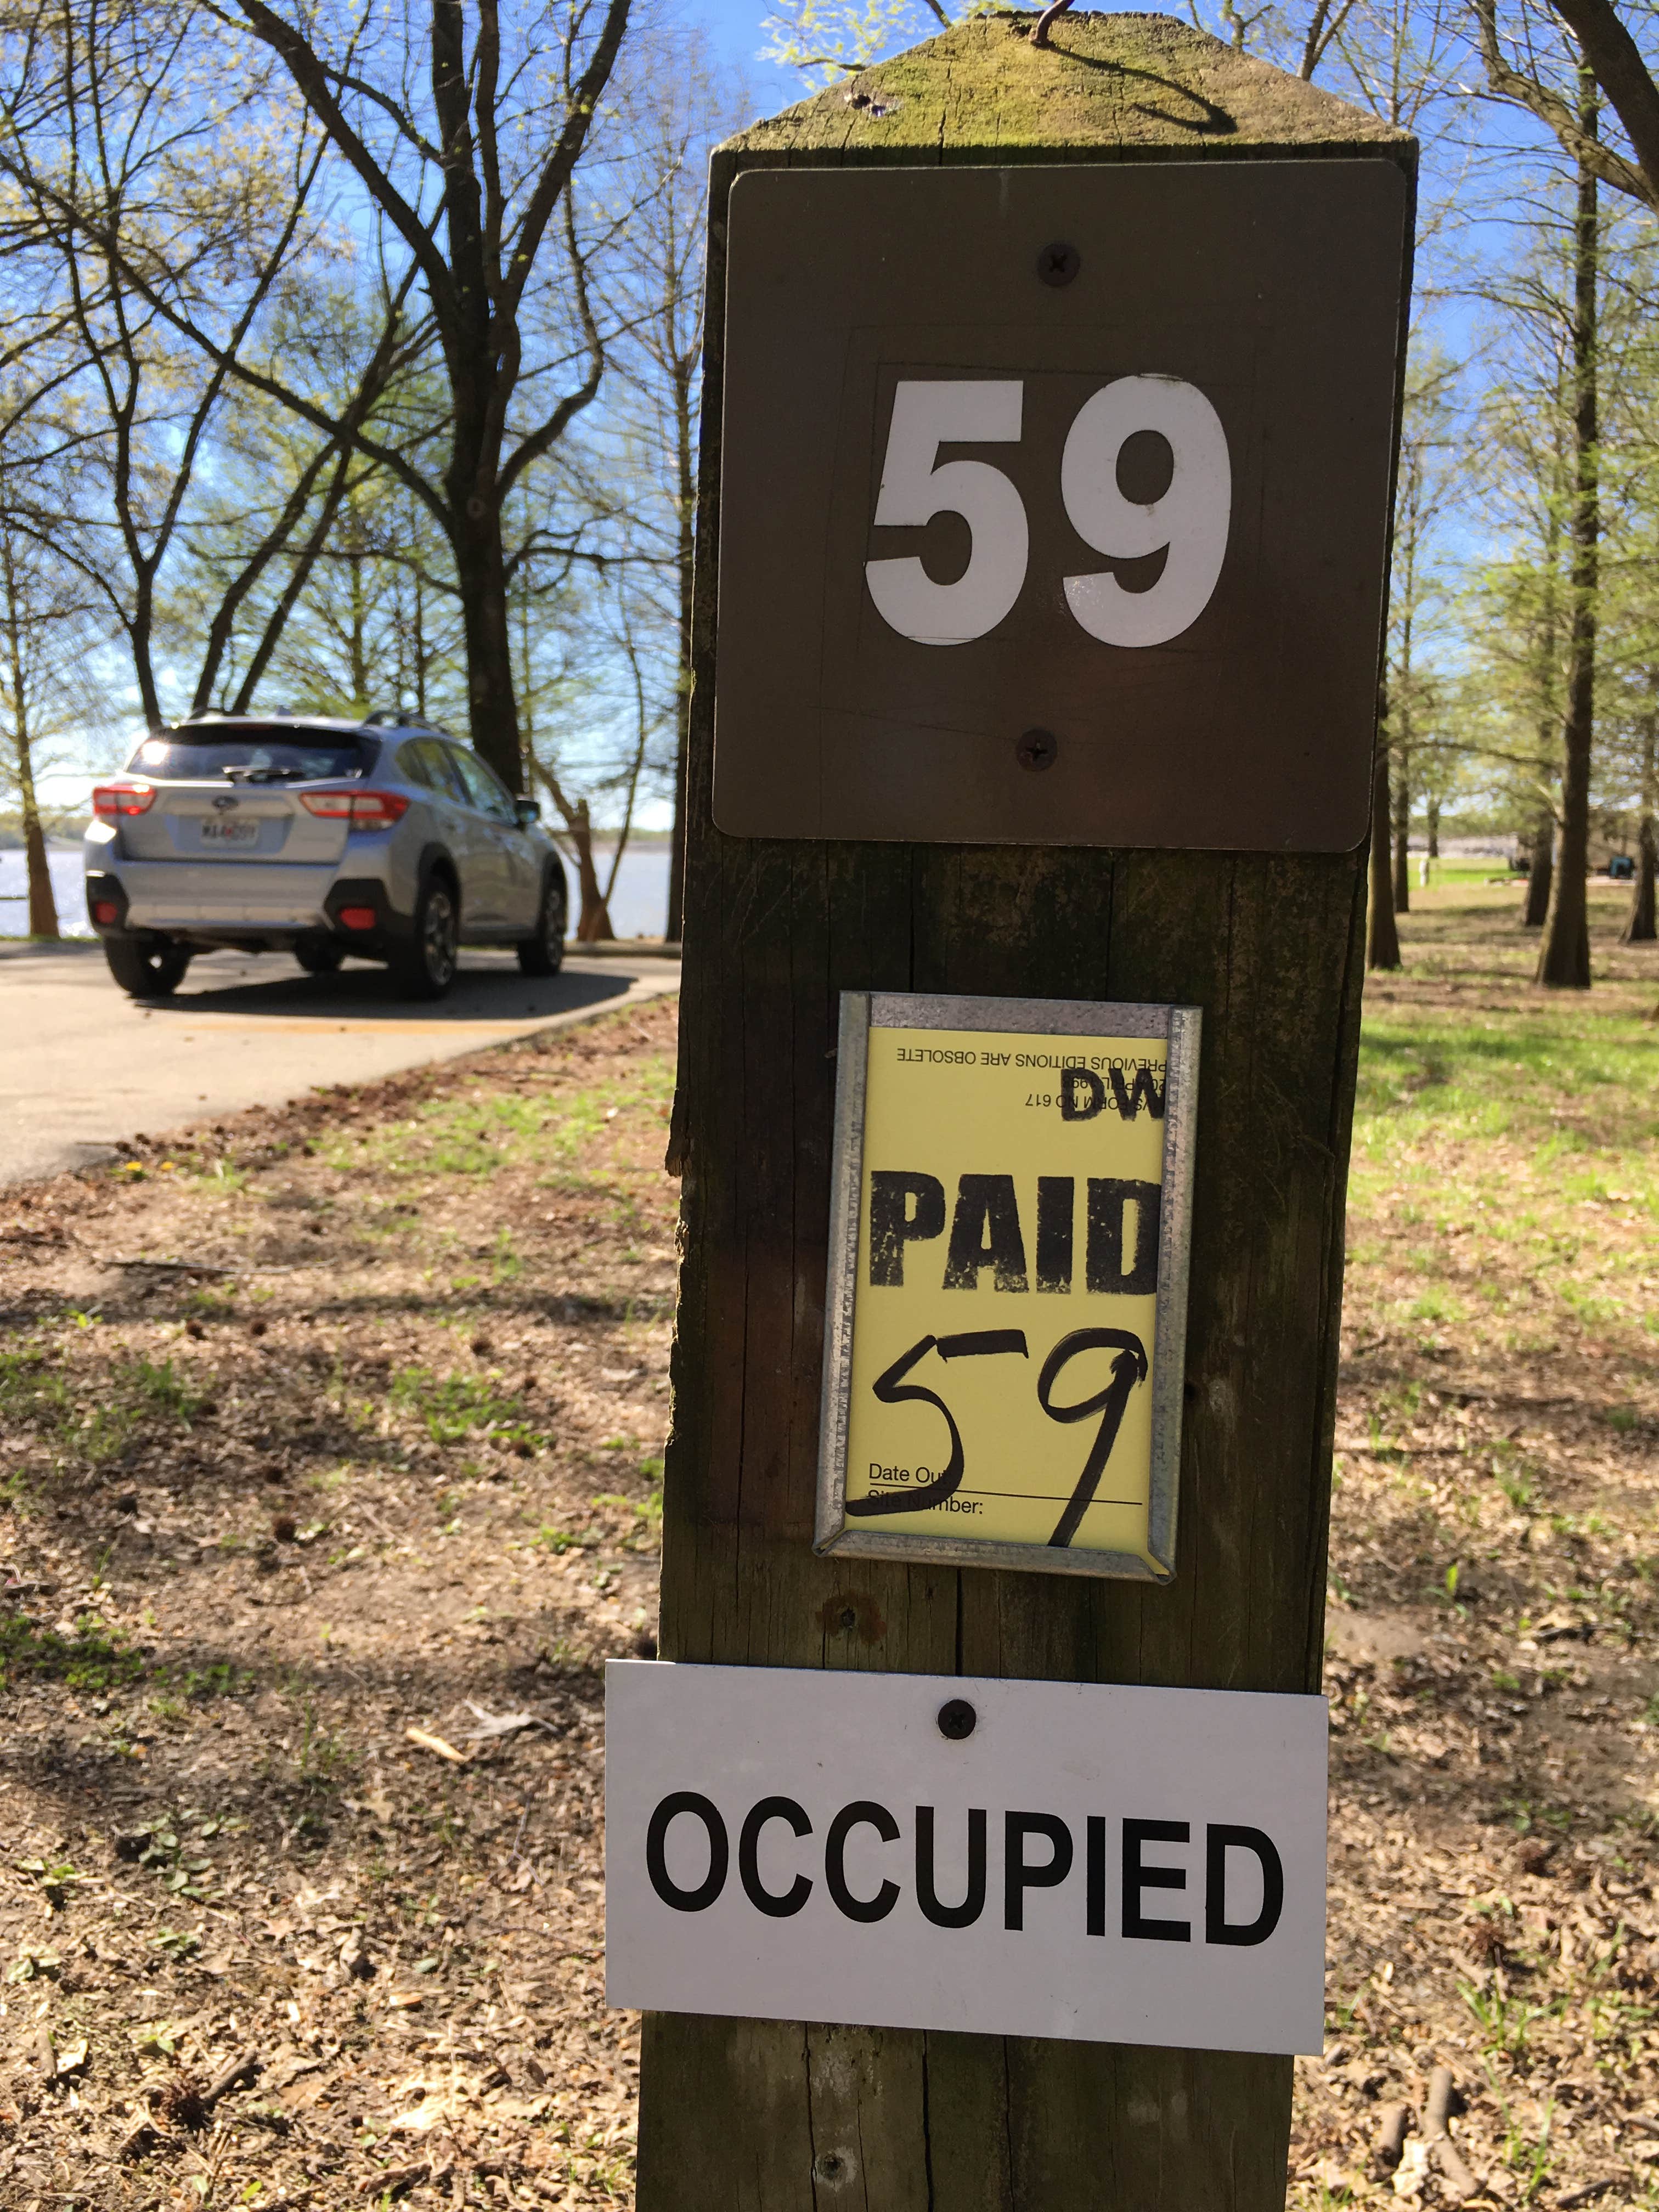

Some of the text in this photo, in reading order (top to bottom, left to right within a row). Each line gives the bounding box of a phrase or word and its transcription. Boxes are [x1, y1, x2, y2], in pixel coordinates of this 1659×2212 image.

[865, 373, 1231, 648] 59
[896, 1048, 1166, 1072] PREVIOUS EDITIONS ARE OBSOLETE
[1025, 1093, 1051, 1107] 617
[1061, 1068, 1165, 1121] DW
[1102, 1077, 1148, 1091] PRIL
[870, 1170, 1162, 1296] PAID
[845, 1328, 1148, 1547] 59
[869, 1463, 910, 1482] Date
[908, 1494, 983, 1515] Nmber:
[646, 1792, 1283, 1946] OCCUPIED
